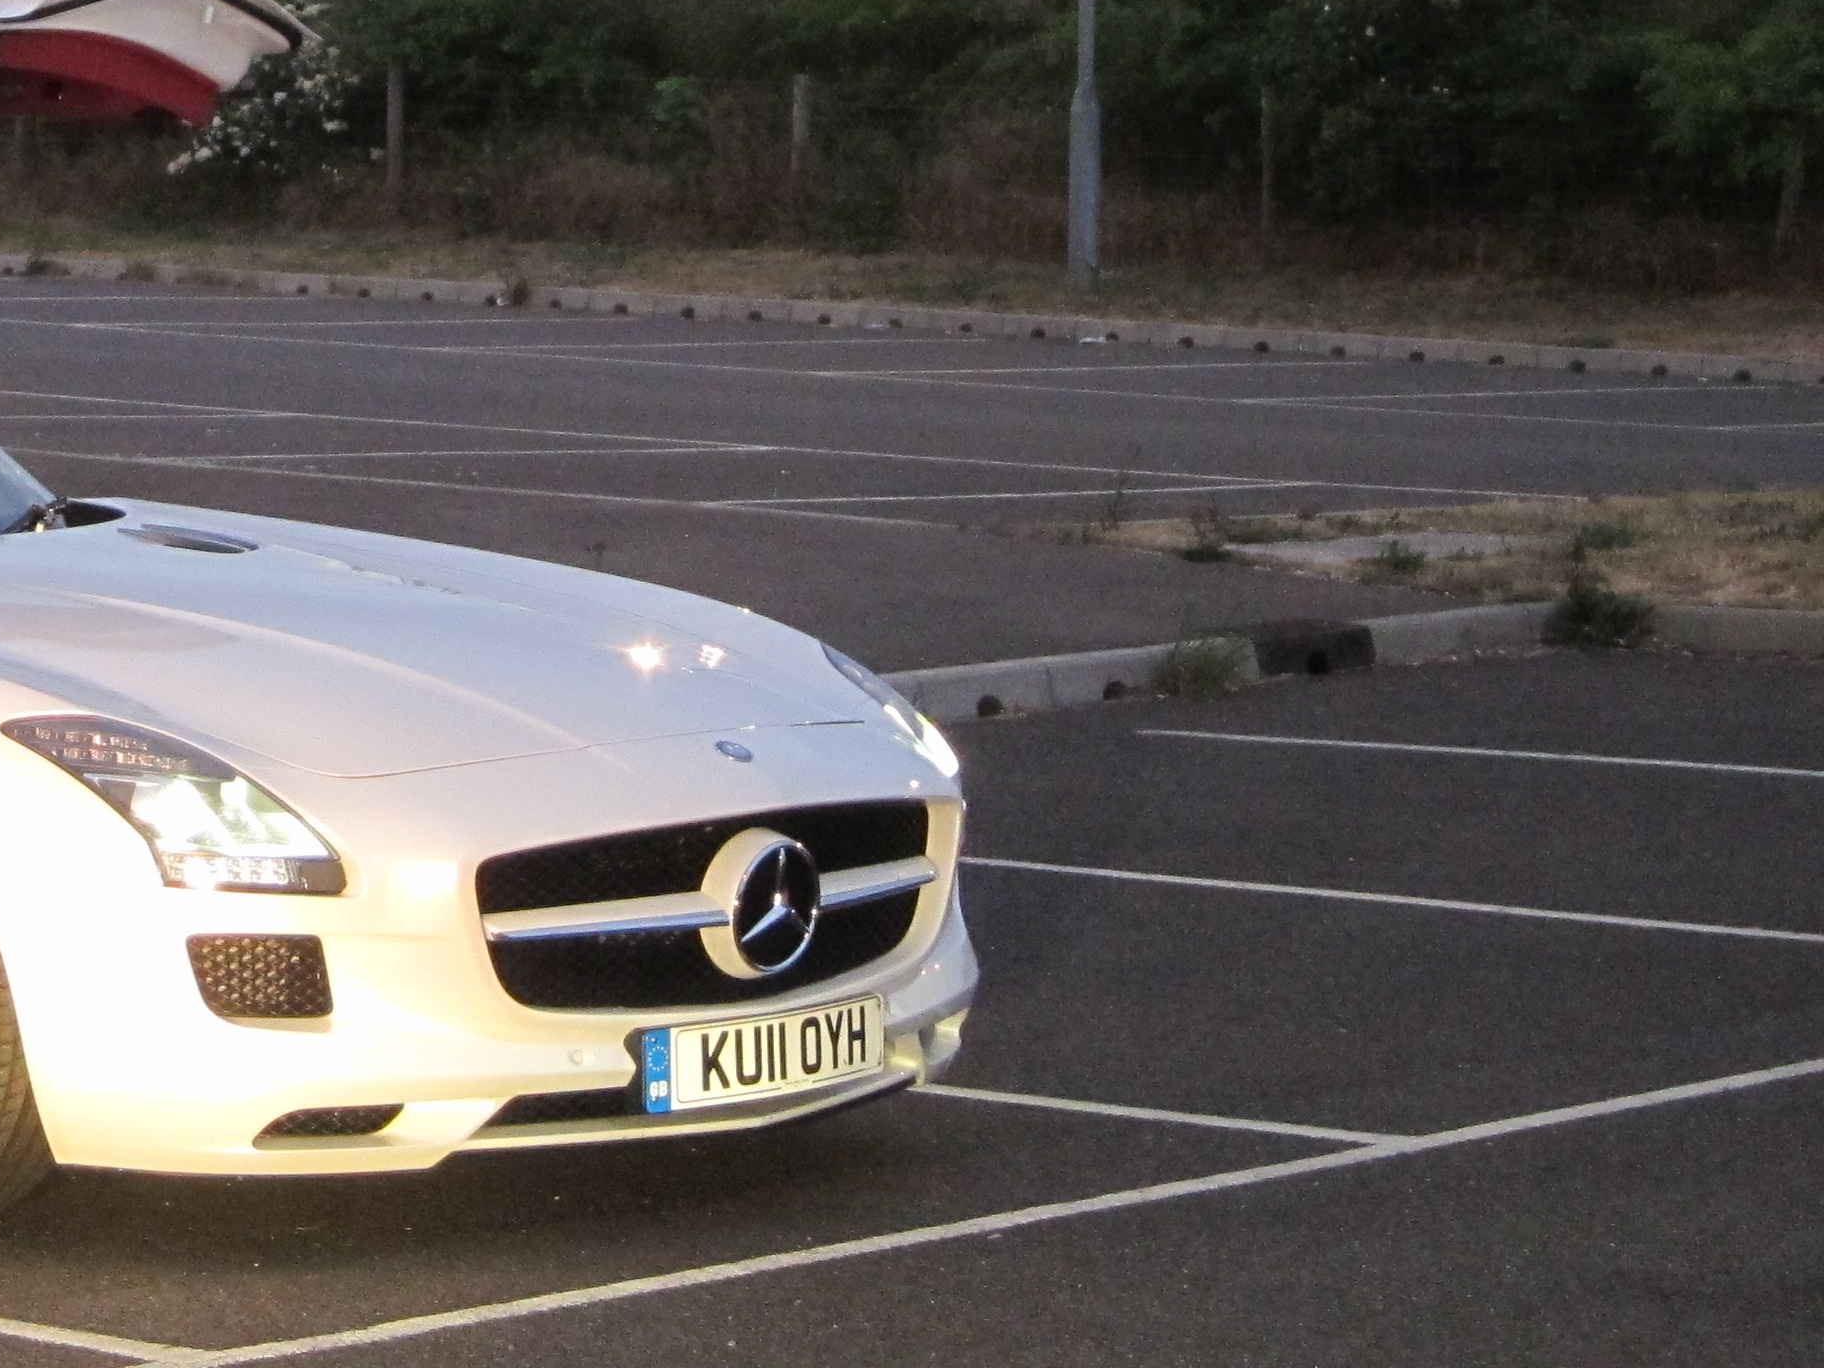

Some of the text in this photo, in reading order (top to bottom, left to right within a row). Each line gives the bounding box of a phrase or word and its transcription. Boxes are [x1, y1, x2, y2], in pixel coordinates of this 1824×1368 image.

[700, 1005, 867, 1092] KU11 OYH
[649, 1080, 668, 1098] GB
